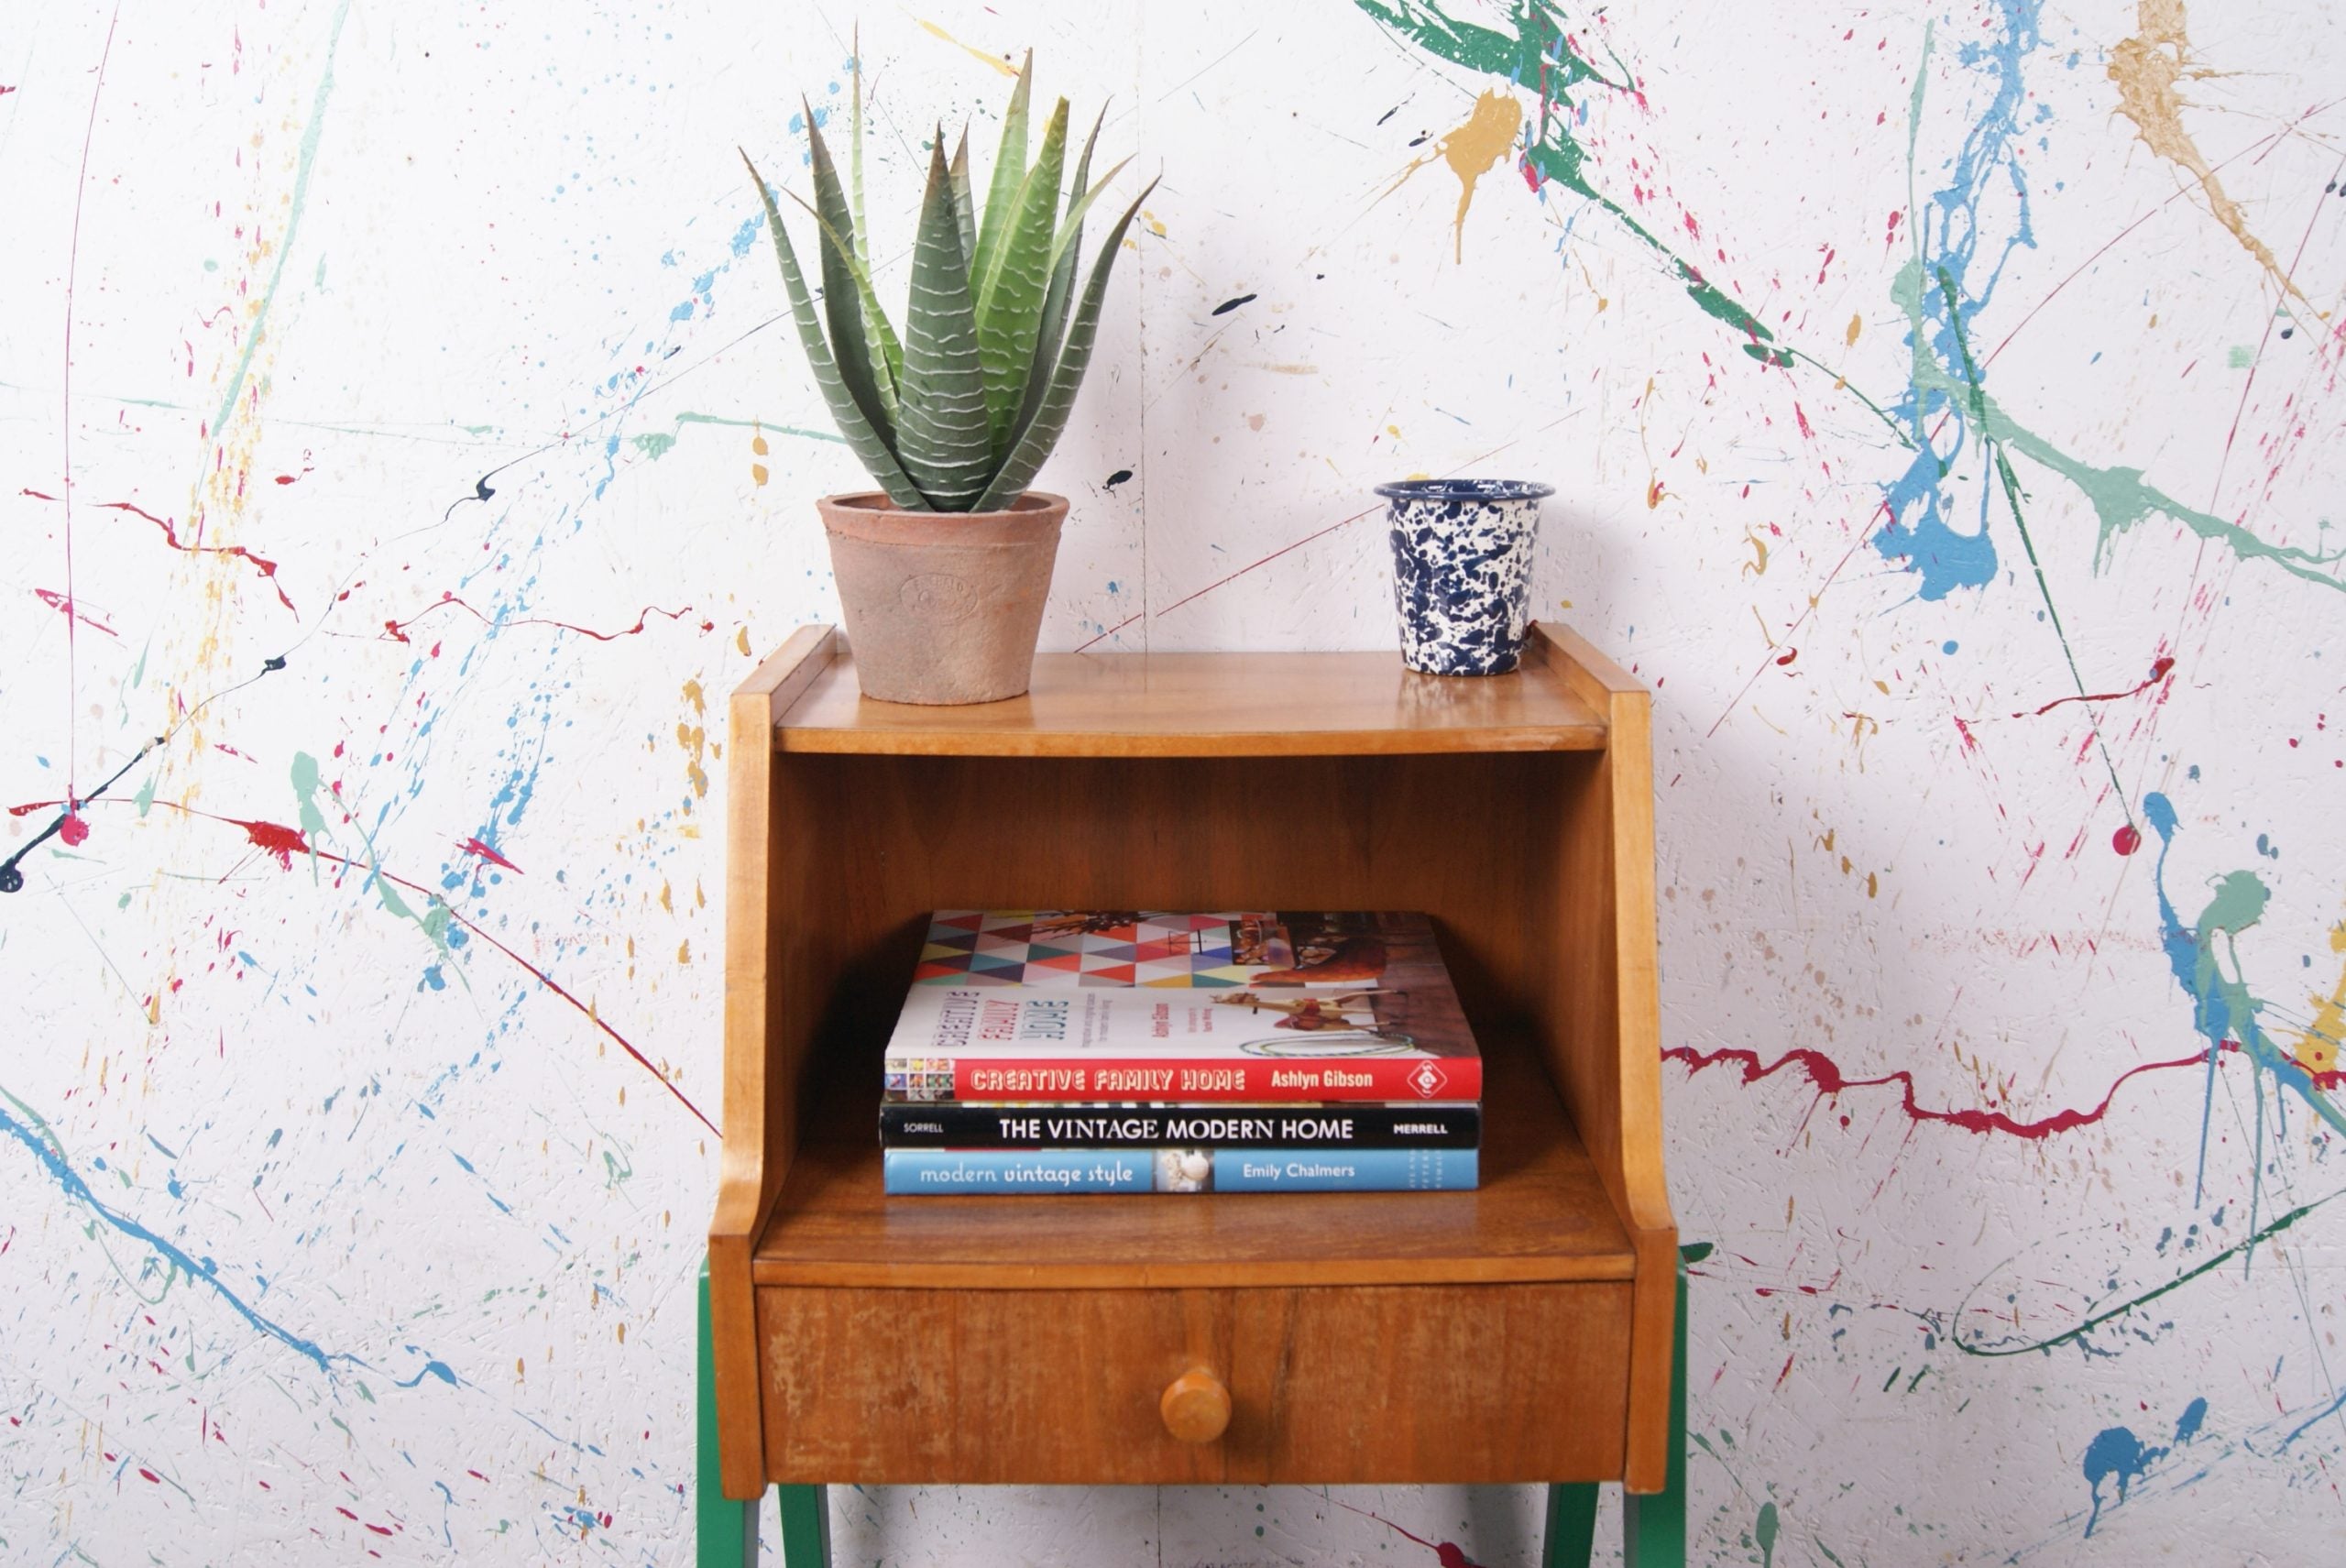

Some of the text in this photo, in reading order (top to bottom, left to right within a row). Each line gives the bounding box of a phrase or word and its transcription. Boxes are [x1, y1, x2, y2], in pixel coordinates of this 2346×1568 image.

[933, 991, 980, 1046] CREATIVE
[978, 1000, 1019, 1040] FAMILY
[1019, 1000, 1069, 1040] HOME
[971, 1069, 1245, 1091] CREATIVE FAMILY HOME
[1271, 1070, 1373, 1091] Ashlyn Gibson
[904, 1123, 944, 1134] SORRELL
[1000, 1119, 1354, 1139] THE VINTAGE MODERN HOME
[1393, 1124, 1448, 1135] MERRELL
[920, 1161, 1133, 1187] modern vintage style
[1243, 1162, 1355, 1180] Emily Chalmers
